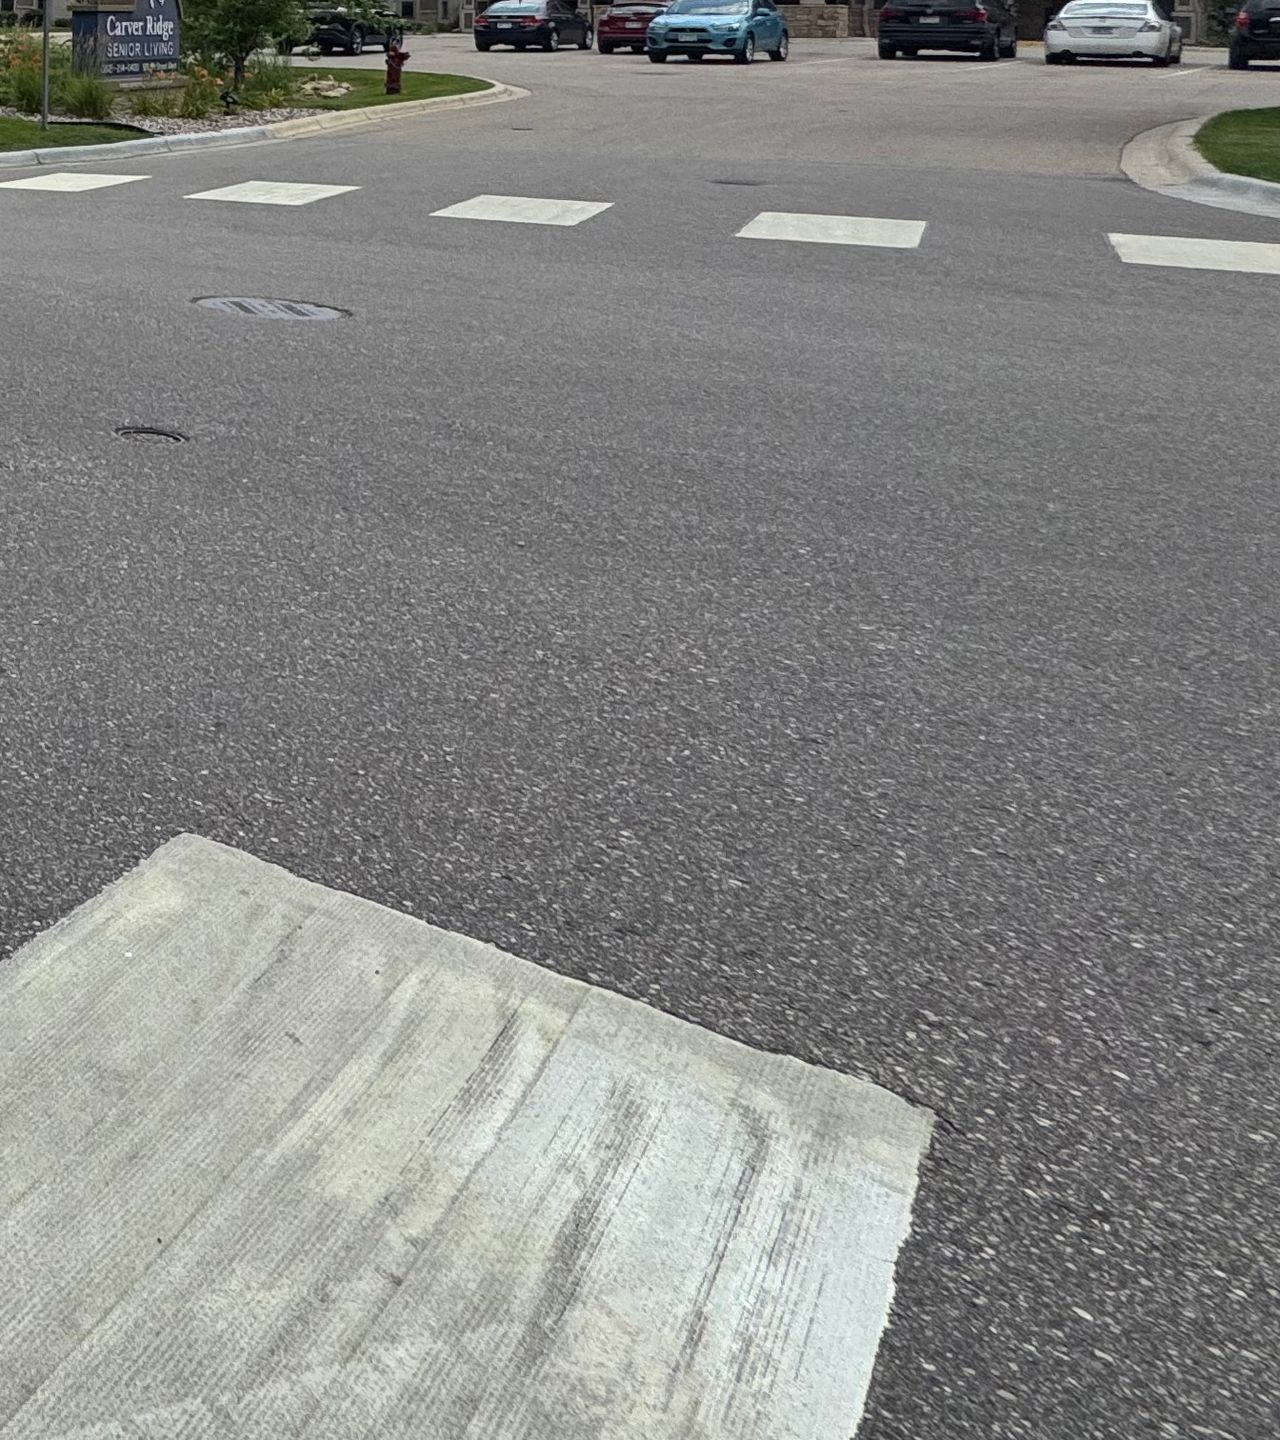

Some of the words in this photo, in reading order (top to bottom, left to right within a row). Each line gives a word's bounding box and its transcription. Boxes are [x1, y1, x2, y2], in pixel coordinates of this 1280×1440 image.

[106, 15, 144, 36] Carver
[146, 14, 174, 41] Ridge
[106, 42, 141, 57] SENIOR
[144, 41, 174, 56] LIVING
